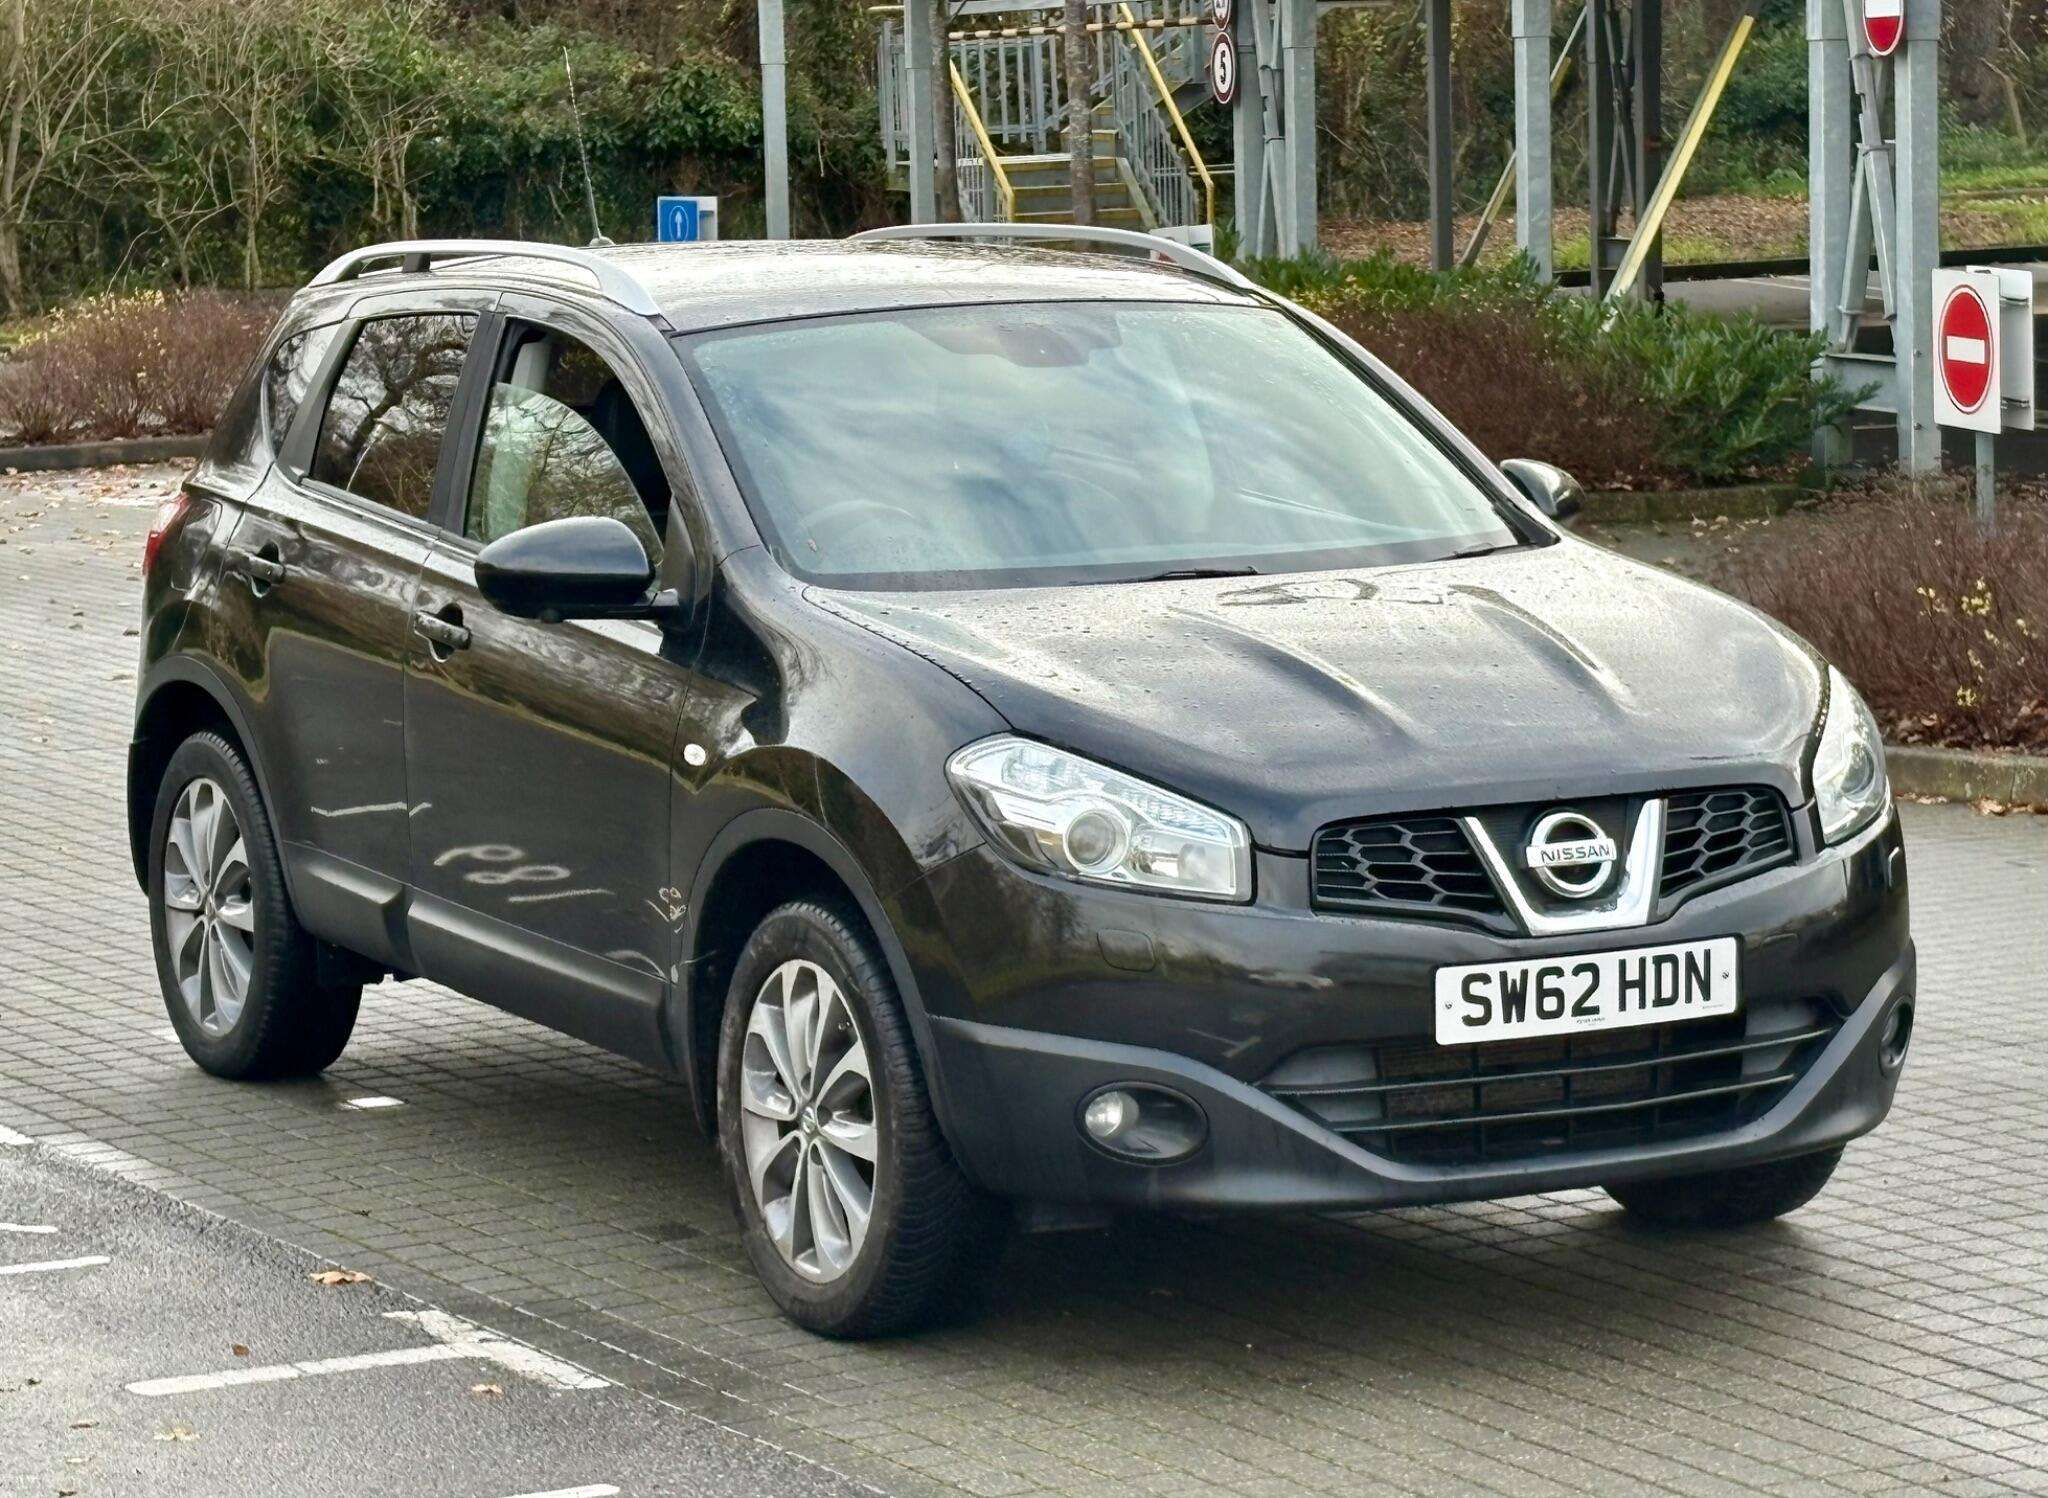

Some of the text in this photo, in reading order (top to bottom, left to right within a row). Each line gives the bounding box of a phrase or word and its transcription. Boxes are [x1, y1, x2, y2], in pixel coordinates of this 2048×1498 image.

[1220, 50, 1227, 85] 5
[1540, 844, 1610, 863] NISSAN
[1460, 948, 1712, 1028] SW62 HDN
